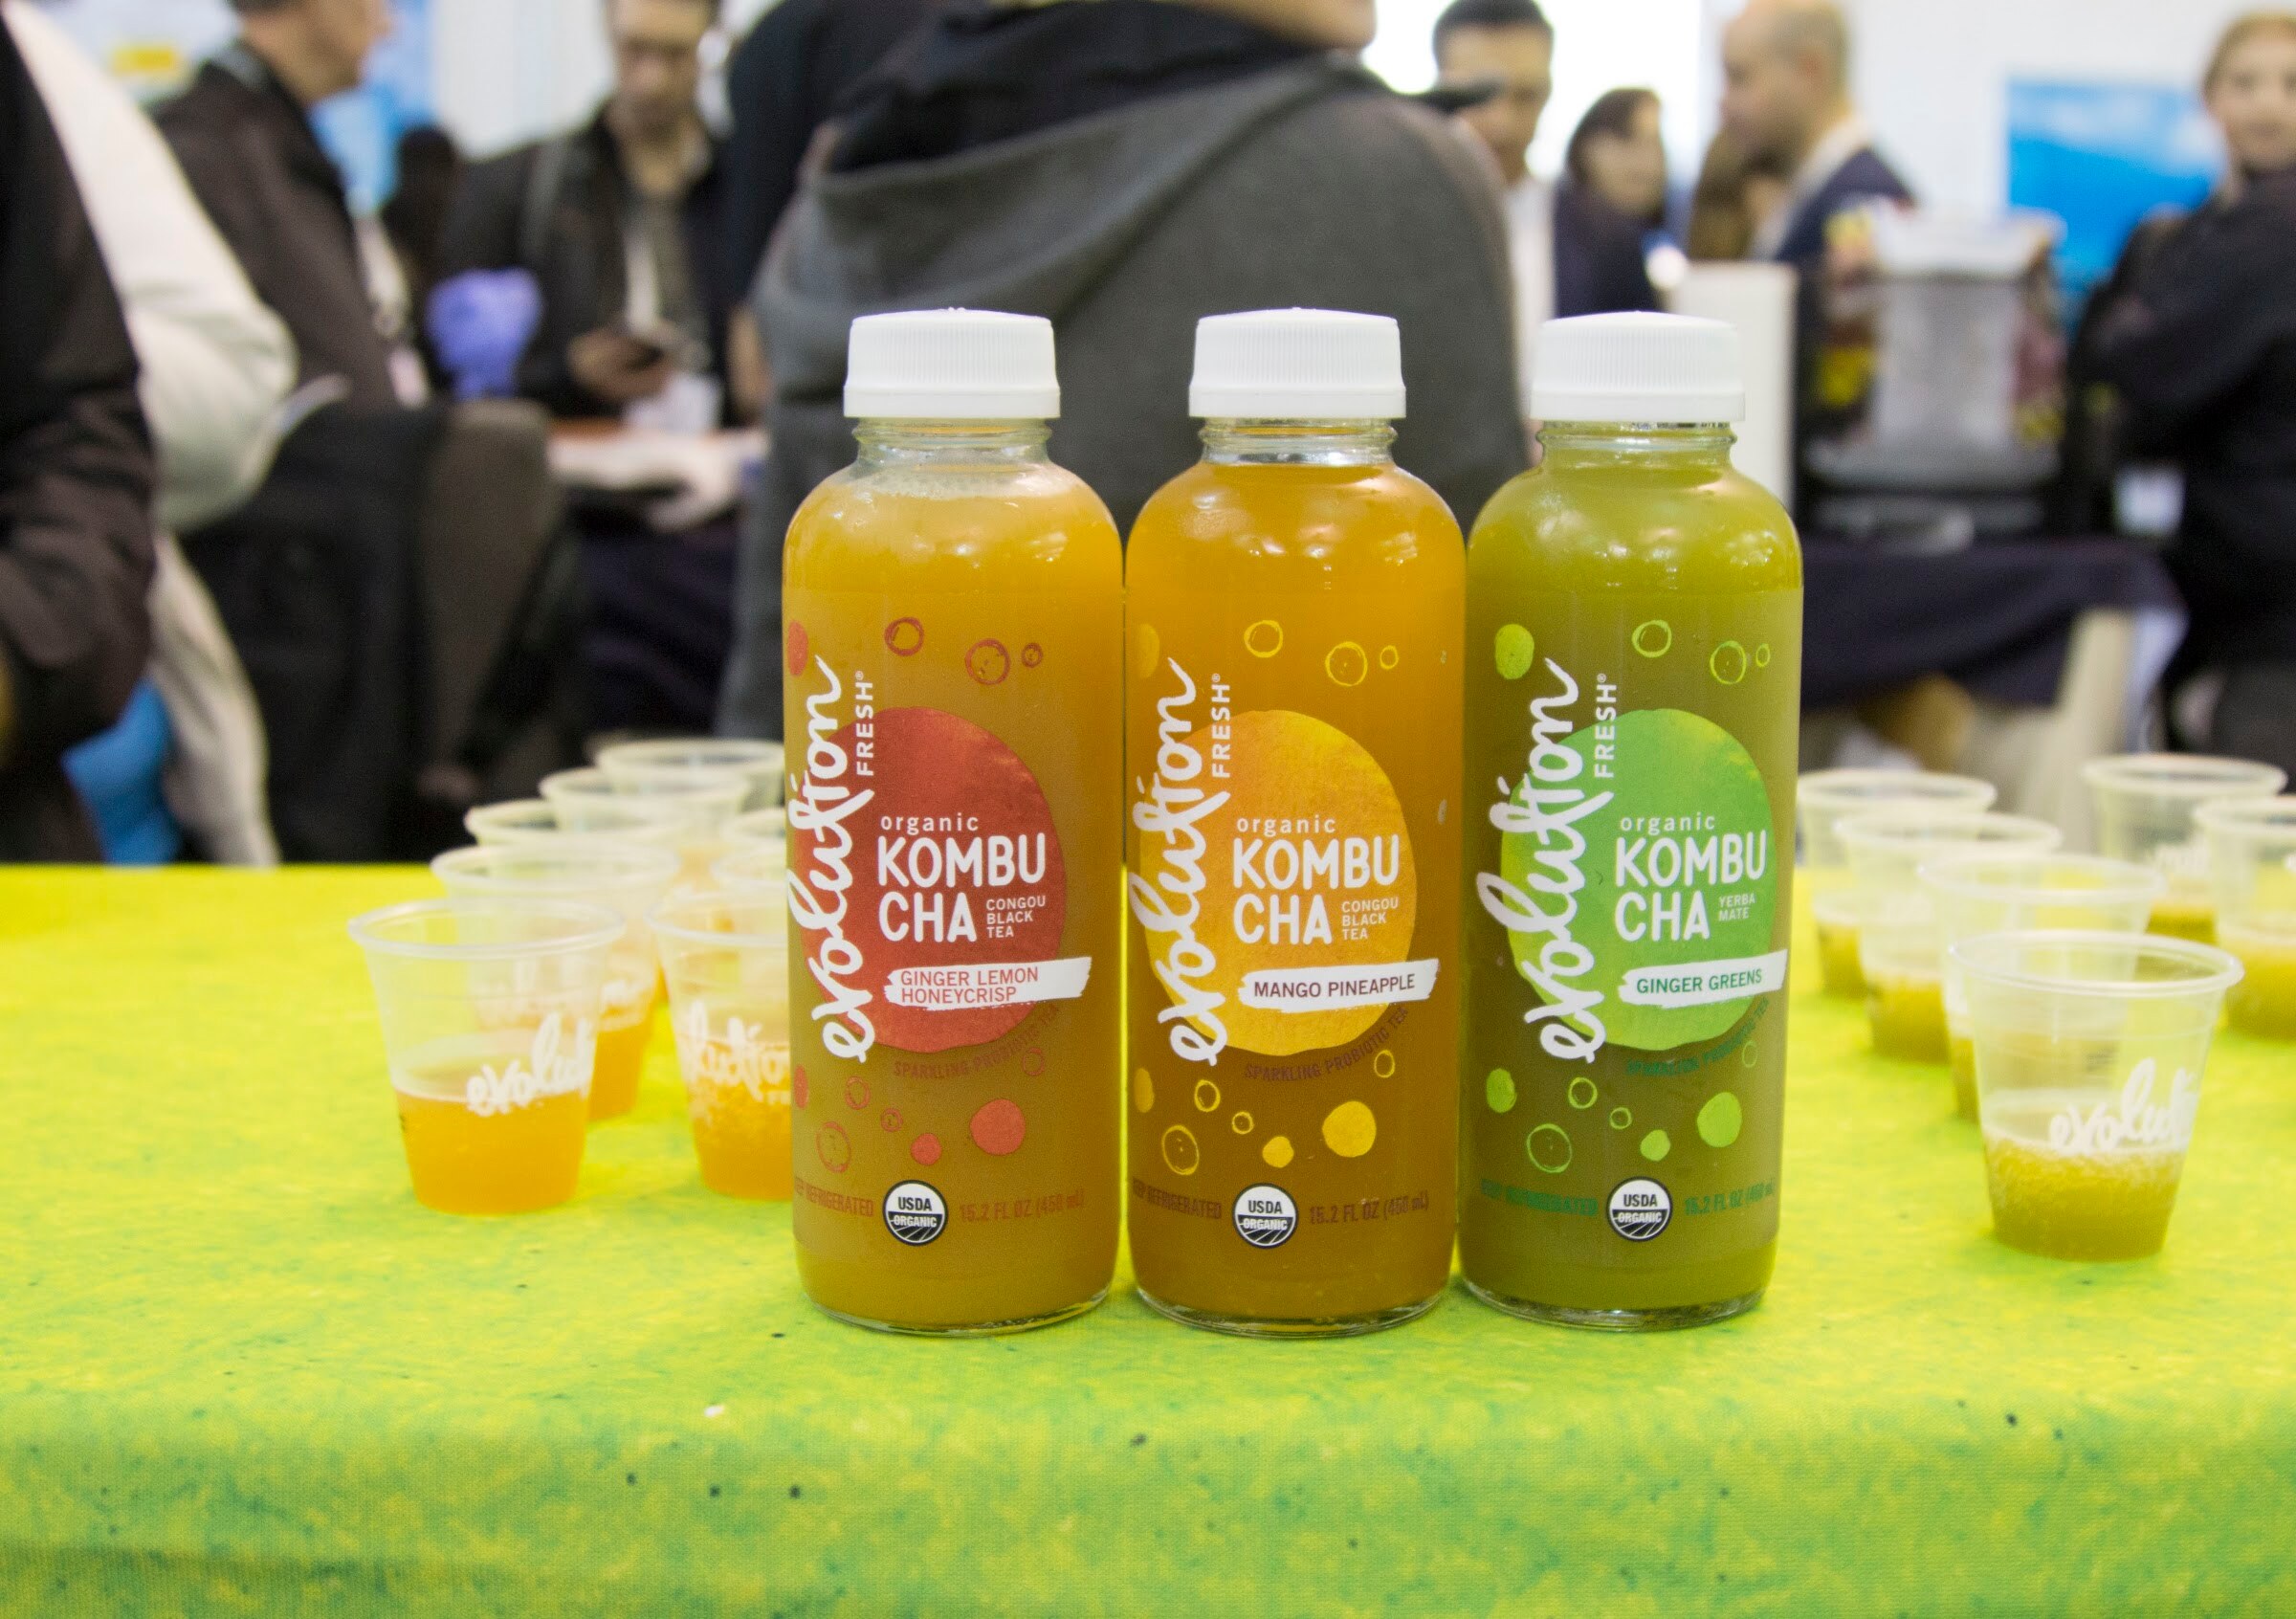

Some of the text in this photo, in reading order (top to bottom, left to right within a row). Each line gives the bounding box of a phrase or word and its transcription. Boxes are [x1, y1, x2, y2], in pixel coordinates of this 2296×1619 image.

[880, 812, 980, 835] organic
[1236, 814, 1336, 837] organic
[1620, 811, 1715, 834] organic
[787, 654, 875, 1062] evolution
[877, 832, 1047, 889] KOMBU
[1128, 657, 1230, 1065] evolution
[1232, 834, 1401, 890] KOMBU
[1476, 657, 1614, 1063] evolution
[1614, 829, 1767, 888] KOMBU
[986, 896, 1047, 911] CONGOU
[1341, 898, 1400, 913] CONGOU
[1718, 894, 1755, 908] YERBA
[877, 891, 978, 943] CHA
[986, 910, 1034, 925] BLACK
[1232, 894, 1334, 945] CHA
[1341, 912, 1387, 927] BLACK
[1614, 891, 1711, 943] CHA
[1718, 907, 1750, 921] MATE
[986, 925, 1015, 939] TEA
[1341, 927, 1369, 941] TEA
[900, 965, 1039, 987] GINGER LEMON
[1253, 973, 1416, 998] MANGO PINEAPPLE
[1636, 968, 1763, 994] GINGER GREENS
[900, 986, 1017, 1005] HONEYCRISP
[1324, 1027, 1390, 1075] PROBIOTIC
[897, 1196, 933, 1211] USDA
[994, 1202, 1010, 1220] FL
[1014, 1198, 1032, 1218] OZ
[1247, 1199, 1283, 1214] USDA
[1623, 1193, 1658, 1208] USDA
[894, 1214, 938, 1229] ORGANIC
[1309, 1205, 1338, 1224] 15.2
[1342, 1204, 1358, 1222] FL
[1362, 1201, 1380, 1220] OZ
[1618, 1210, 1662, 1225] ORGANIC
[1243, 1217, 1288, 1231] ORGANIC
